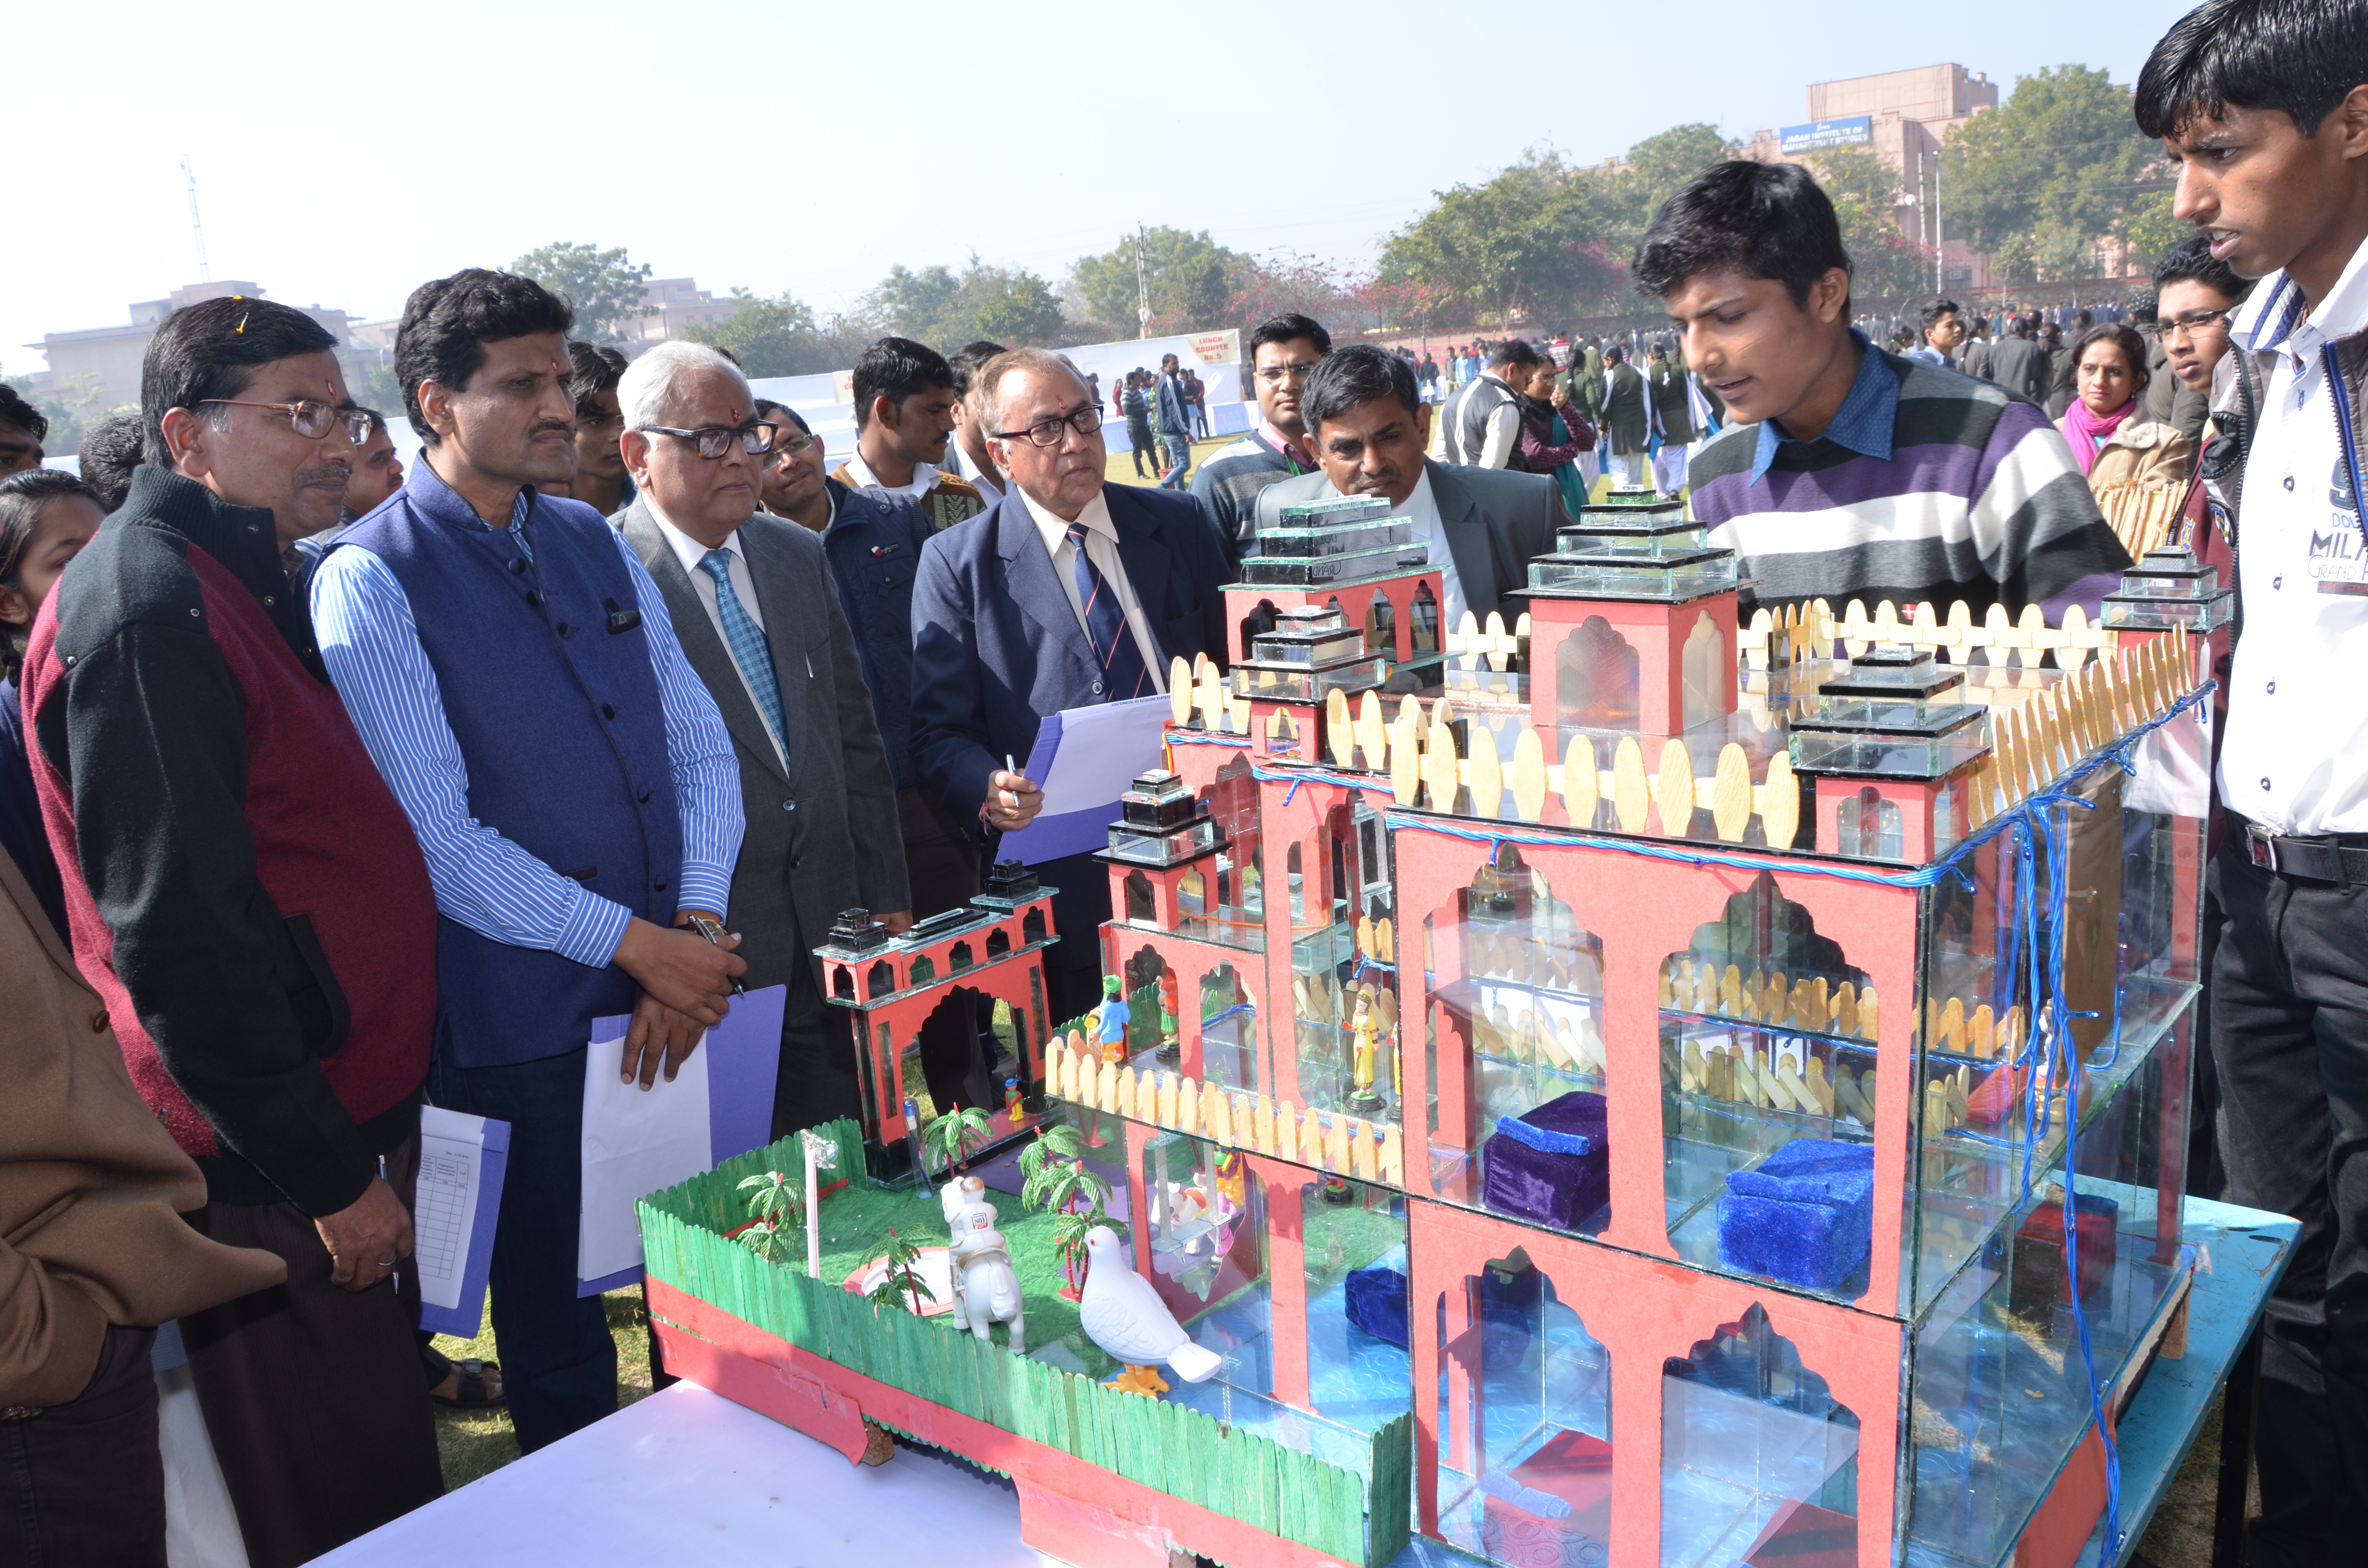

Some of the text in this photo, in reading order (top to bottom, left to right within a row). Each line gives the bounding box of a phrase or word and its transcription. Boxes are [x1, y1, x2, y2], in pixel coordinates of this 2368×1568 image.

[1785, 133, 1811, 143] JAGAN
[1852, 126, 1863, 135] OF
[1199, 336, 1222, 344] LUNCH
[1196, 343, 1228, 353] COUNTER
